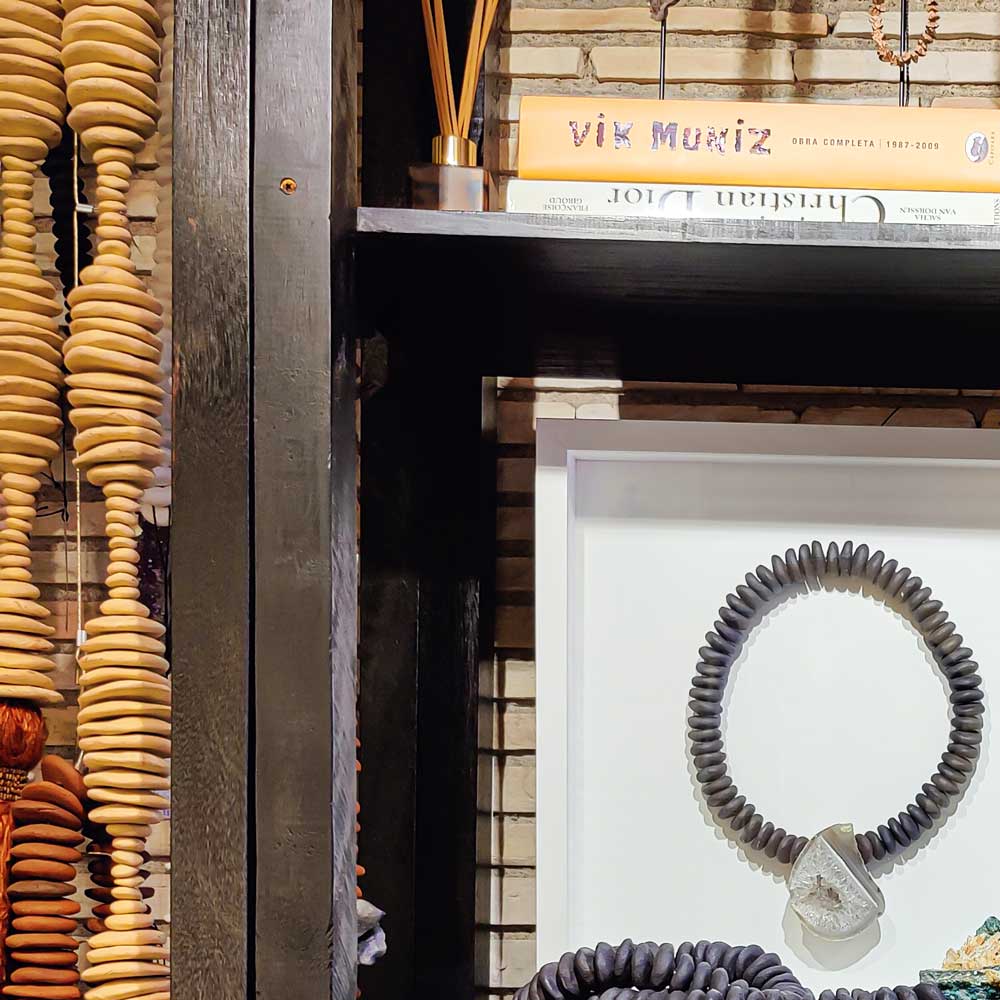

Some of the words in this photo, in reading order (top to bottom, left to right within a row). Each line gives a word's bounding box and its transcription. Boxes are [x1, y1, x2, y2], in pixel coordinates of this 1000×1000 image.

[791, 137, 818, 147] OBRA
[823, 138, 876, 149] COMPLETA
[886, 140, 940, 151] 1987-2009
[549, 197, 583, 205] GIROUD
[607, 188, 700, 216] Dior
[715, 191, 886, 224] Christian
[938, 208, 957, 216] VAN
